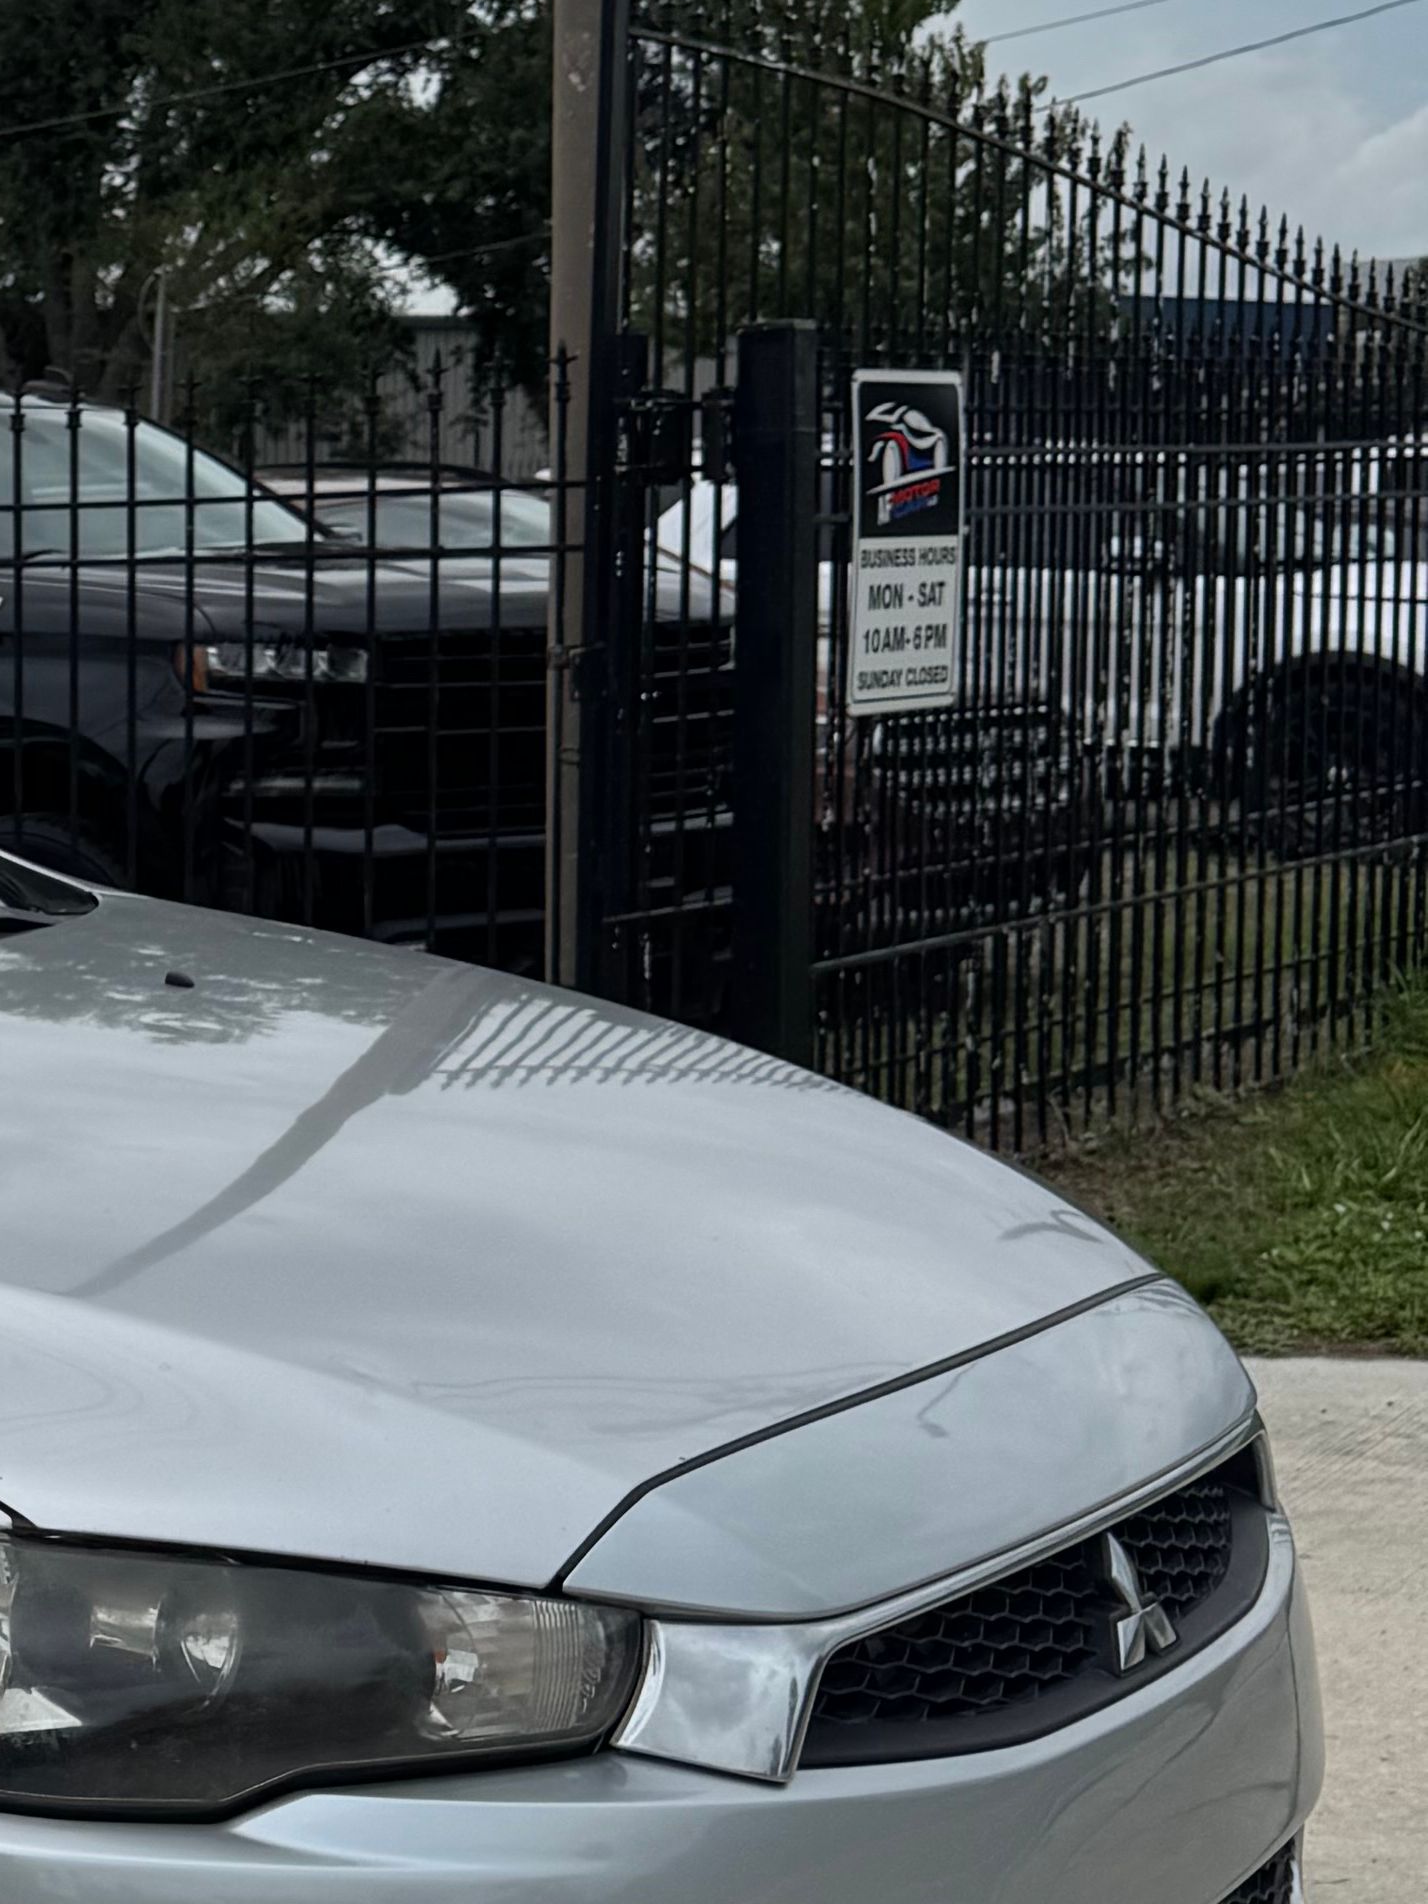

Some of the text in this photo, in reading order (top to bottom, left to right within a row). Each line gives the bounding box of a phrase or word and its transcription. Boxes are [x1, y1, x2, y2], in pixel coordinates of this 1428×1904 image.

[861, 545, 956, 568] BUSINESS HOURS
[868, 583, 904, 610] MON
[917, 580, 946, 607] SAT
[858, 664, 948, 691] SUNDAY CLOSED
